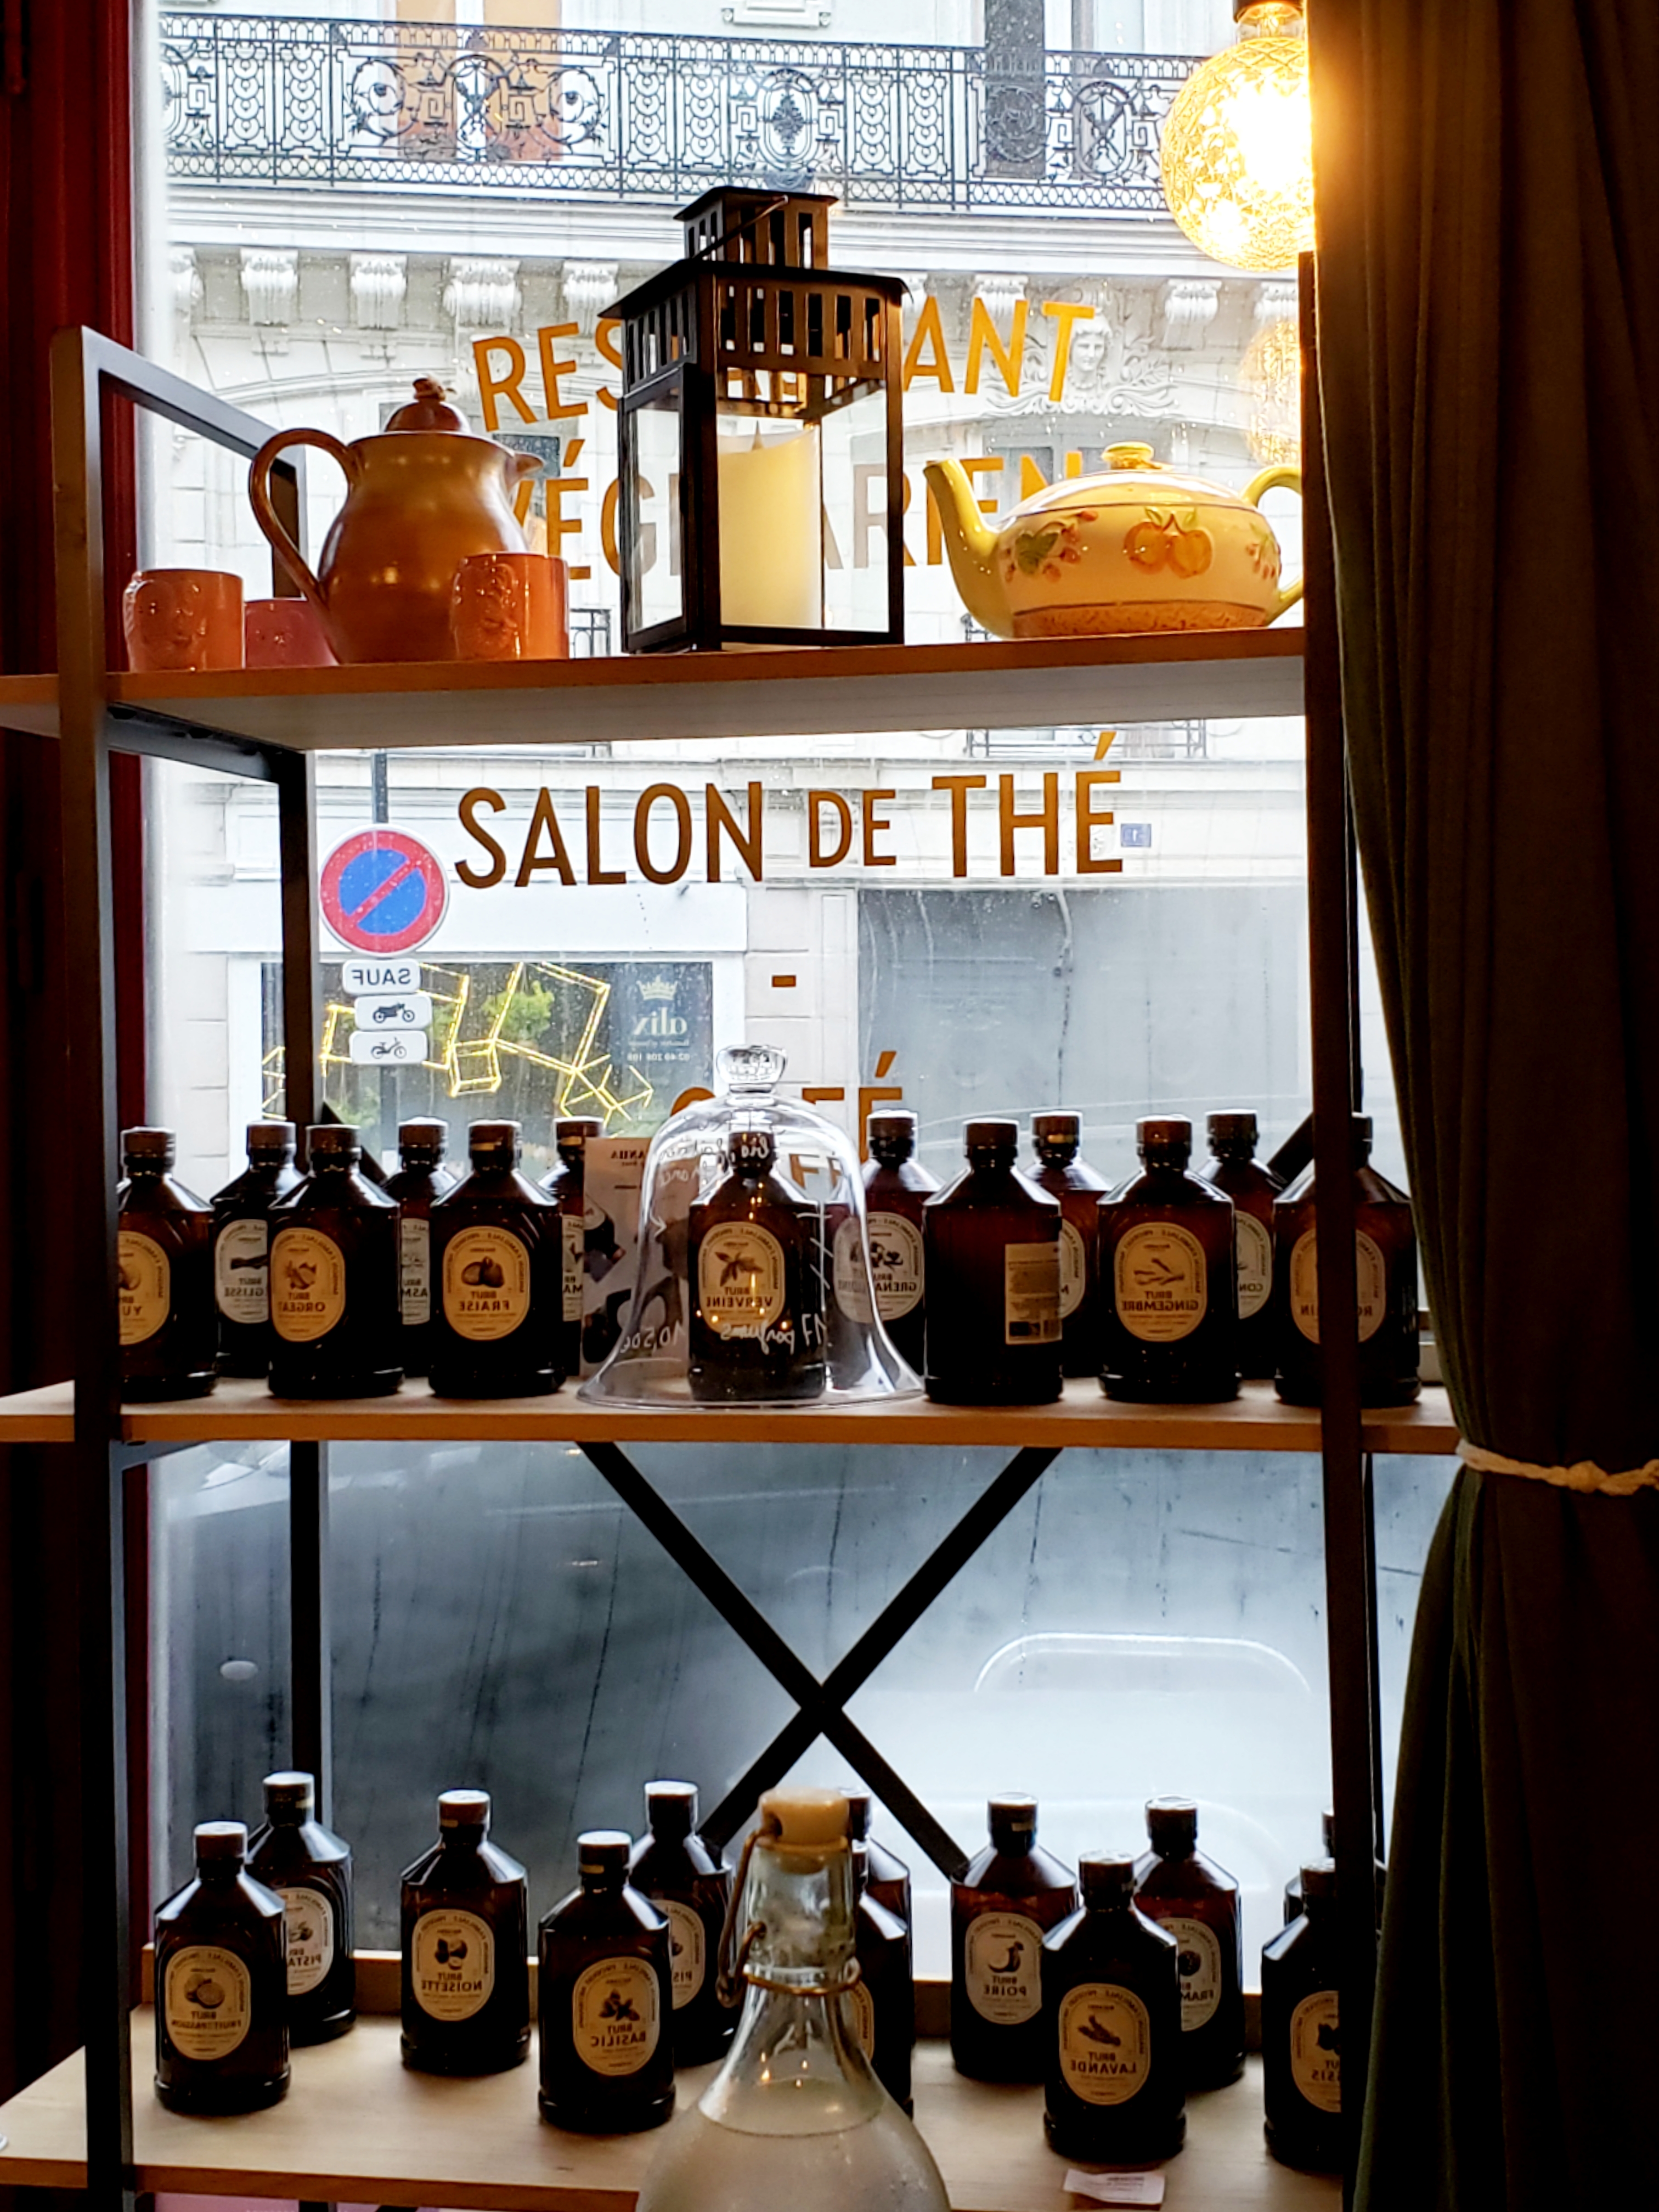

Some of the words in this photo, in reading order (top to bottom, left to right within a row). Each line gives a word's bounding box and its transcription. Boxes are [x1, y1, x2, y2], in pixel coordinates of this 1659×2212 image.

[472, 295, 1095, 432] RESANT
[454, 781, 763, 889] SALON
[809, 790, 896, 868] DE
[932, 731, 1122, 877] THÉ
